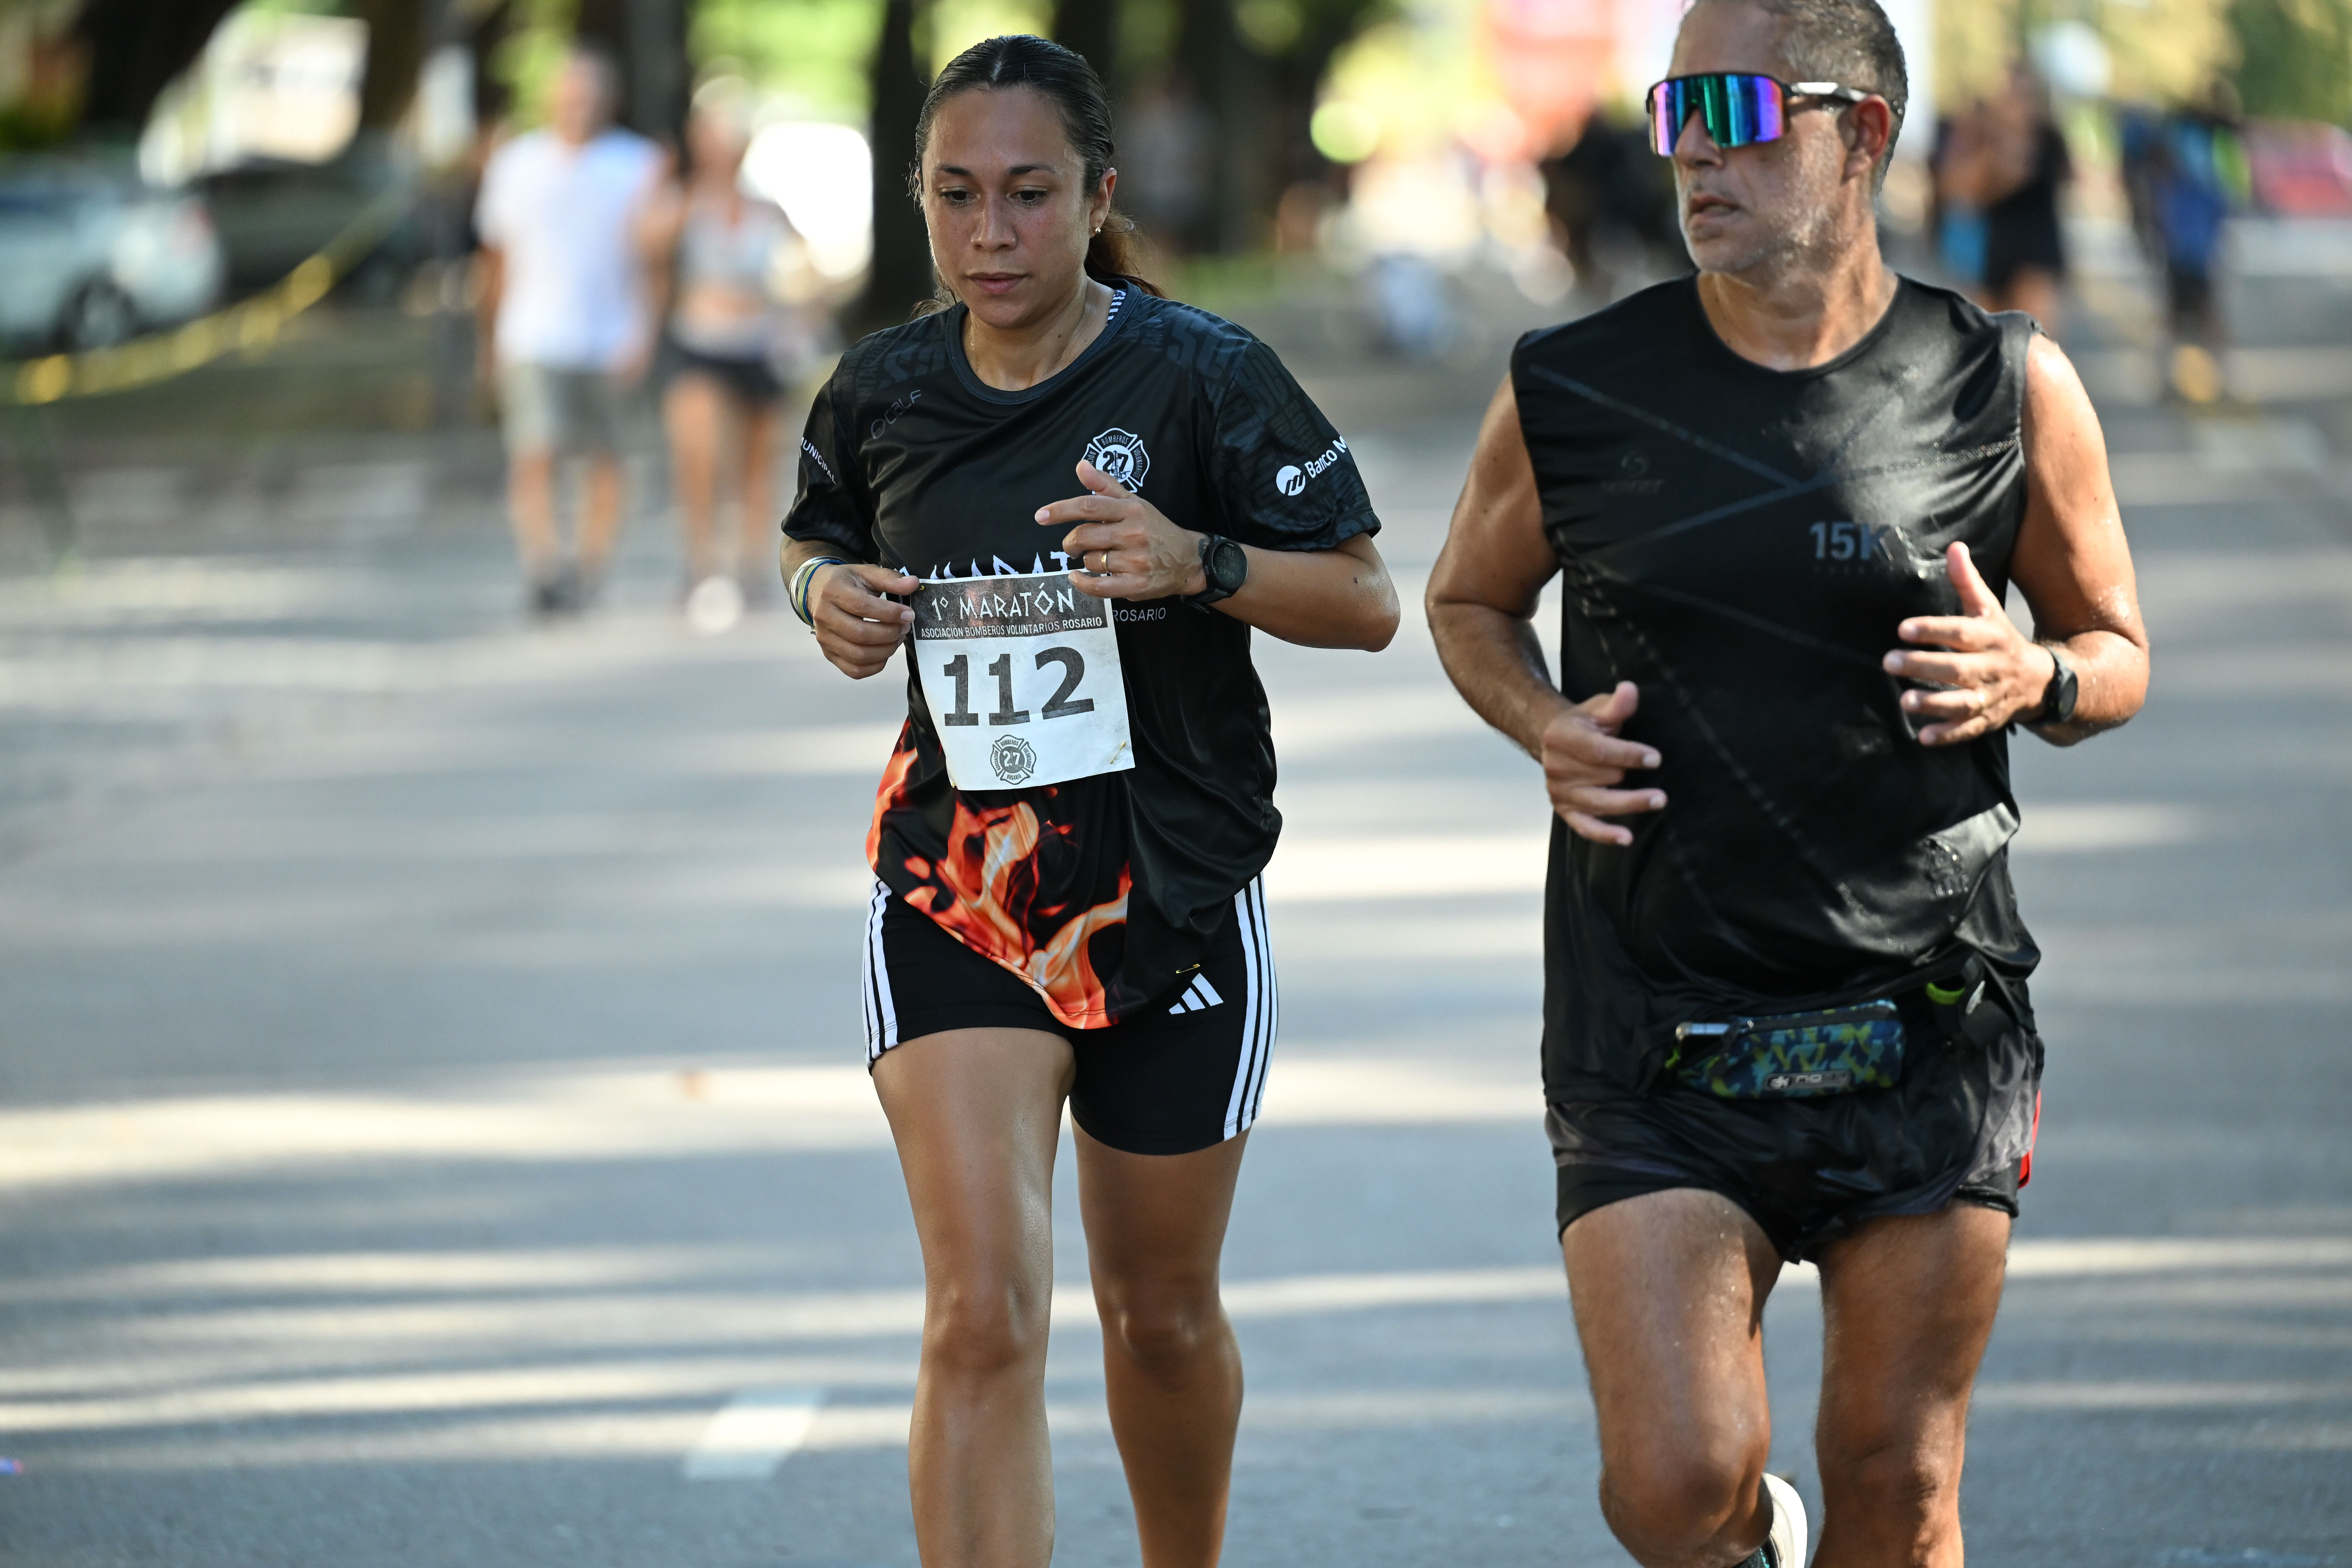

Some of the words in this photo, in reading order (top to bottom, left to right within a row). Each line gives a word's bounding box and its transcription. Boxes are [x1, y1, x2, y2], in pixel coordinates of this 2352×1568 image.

[1101, 435, 1129, 446] BOMBEROS
[1102, 450, 1129, 474] 27
[1133, 448, 1143, 479] VOLUNTARIOS
[1304, 450, 1338, 478] Banco
[1809, 521, 1890, 560] 15K
[959, 582, 1075, 620] MARATÓN
[1113, 607, 1166, 621] ROSARIO
[965, 625, 1005, 637] BOMBEROS
[1006, 621, 1060, 635] VOLUNTARIOS
[1062, 616, 1102, 629] ROSARIO
[943, 646, 1095, 726] 112
[1003, 750, 1020, 767] 27
